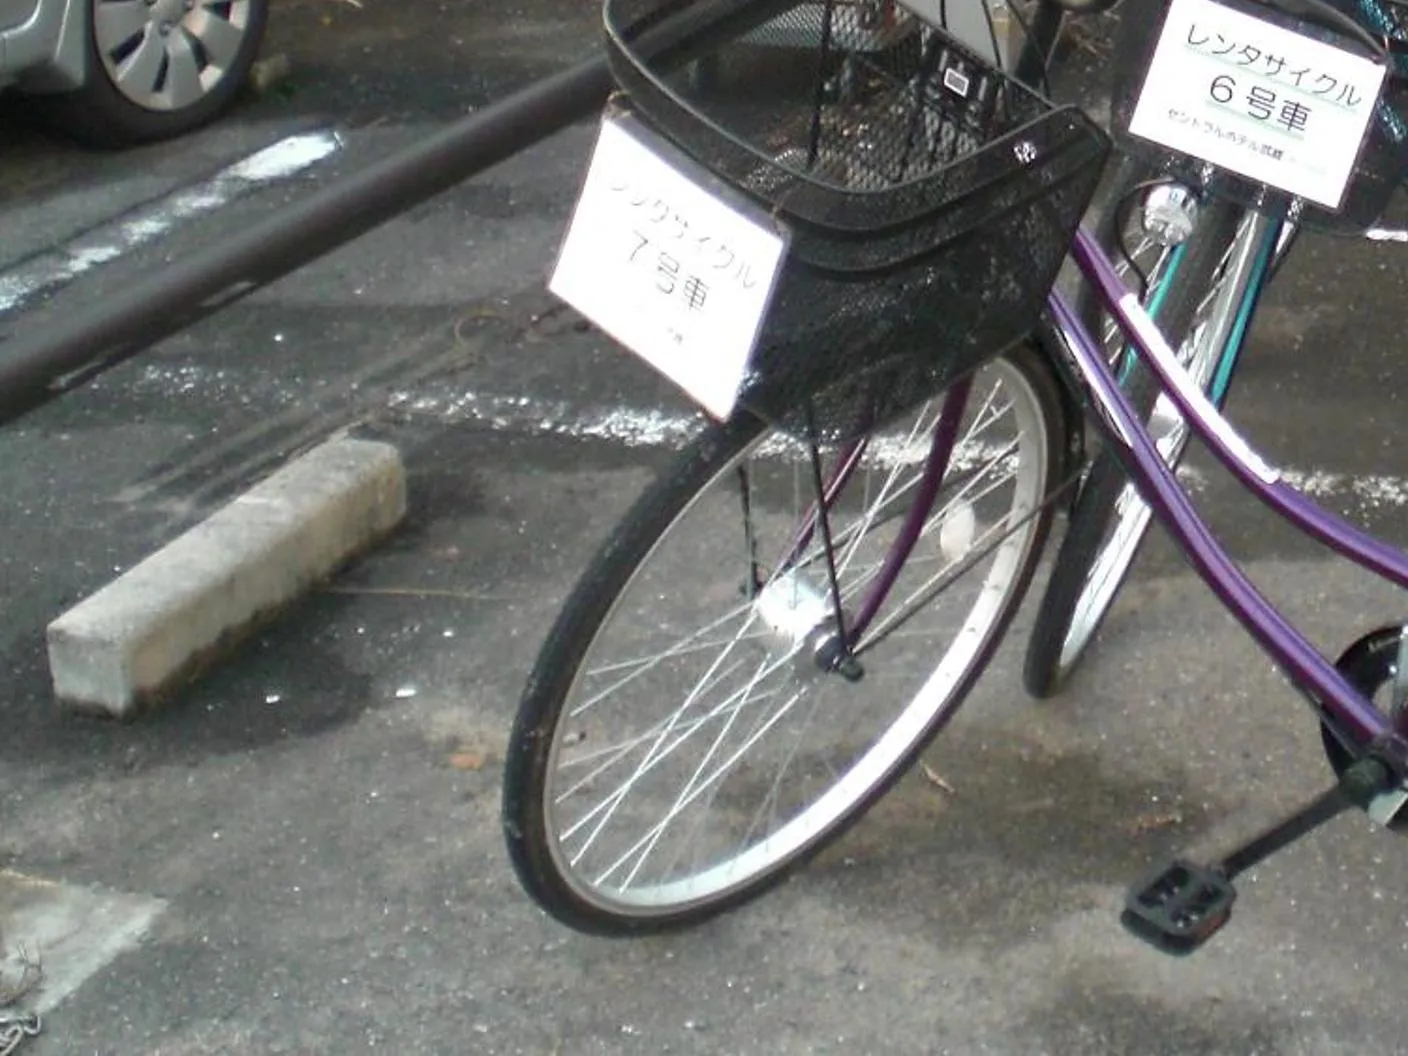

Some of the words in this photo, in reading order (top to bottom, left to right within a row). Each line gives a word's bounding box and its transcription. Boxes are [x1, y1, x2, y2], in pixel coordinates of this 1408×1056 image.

[1187, 23, 1362, 107] レンタサイクル
[1210, 75, 1312, 132] 6号車
